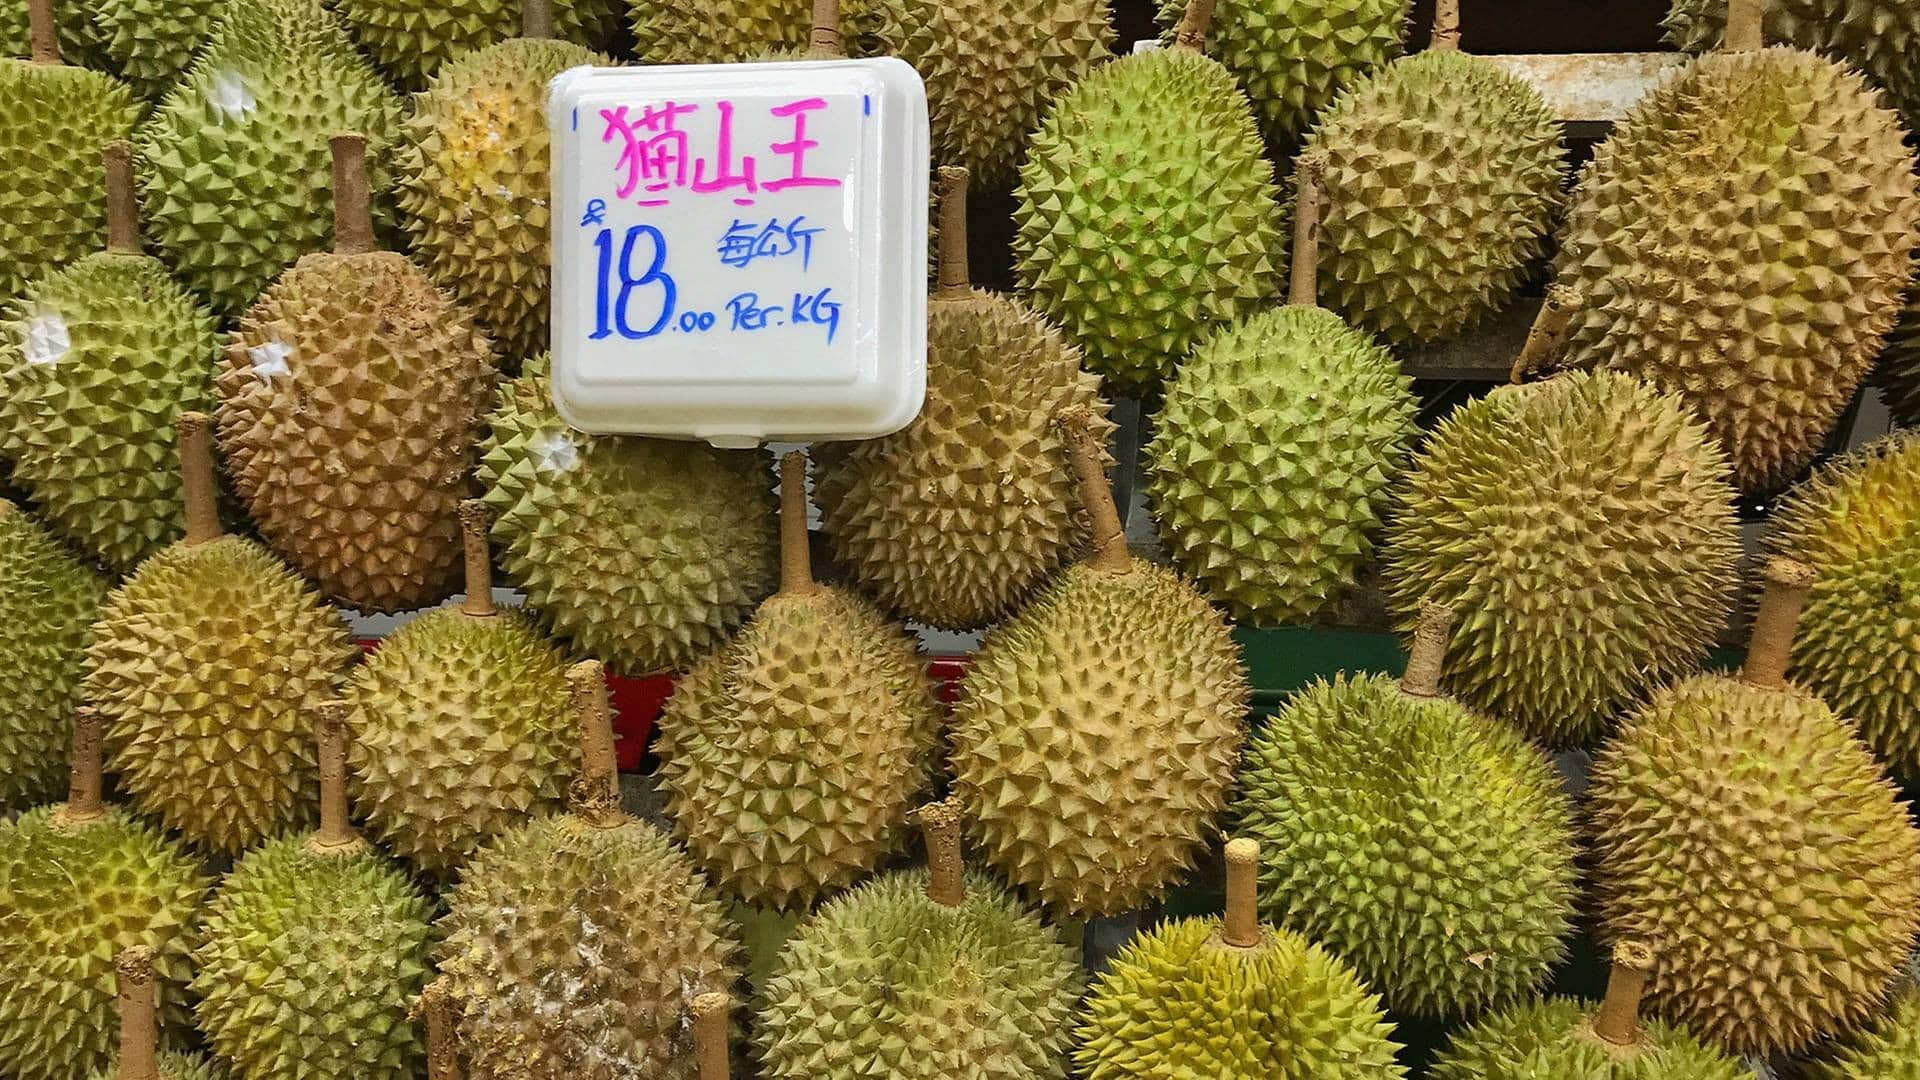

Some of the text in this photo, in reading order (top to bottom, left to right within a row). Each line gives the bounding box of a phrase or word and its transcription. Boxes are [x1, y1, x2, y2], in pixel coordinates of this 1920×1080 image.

[598, 97, 842, 199] 猫山王
[717, 215, 825, 272] 每公斤
